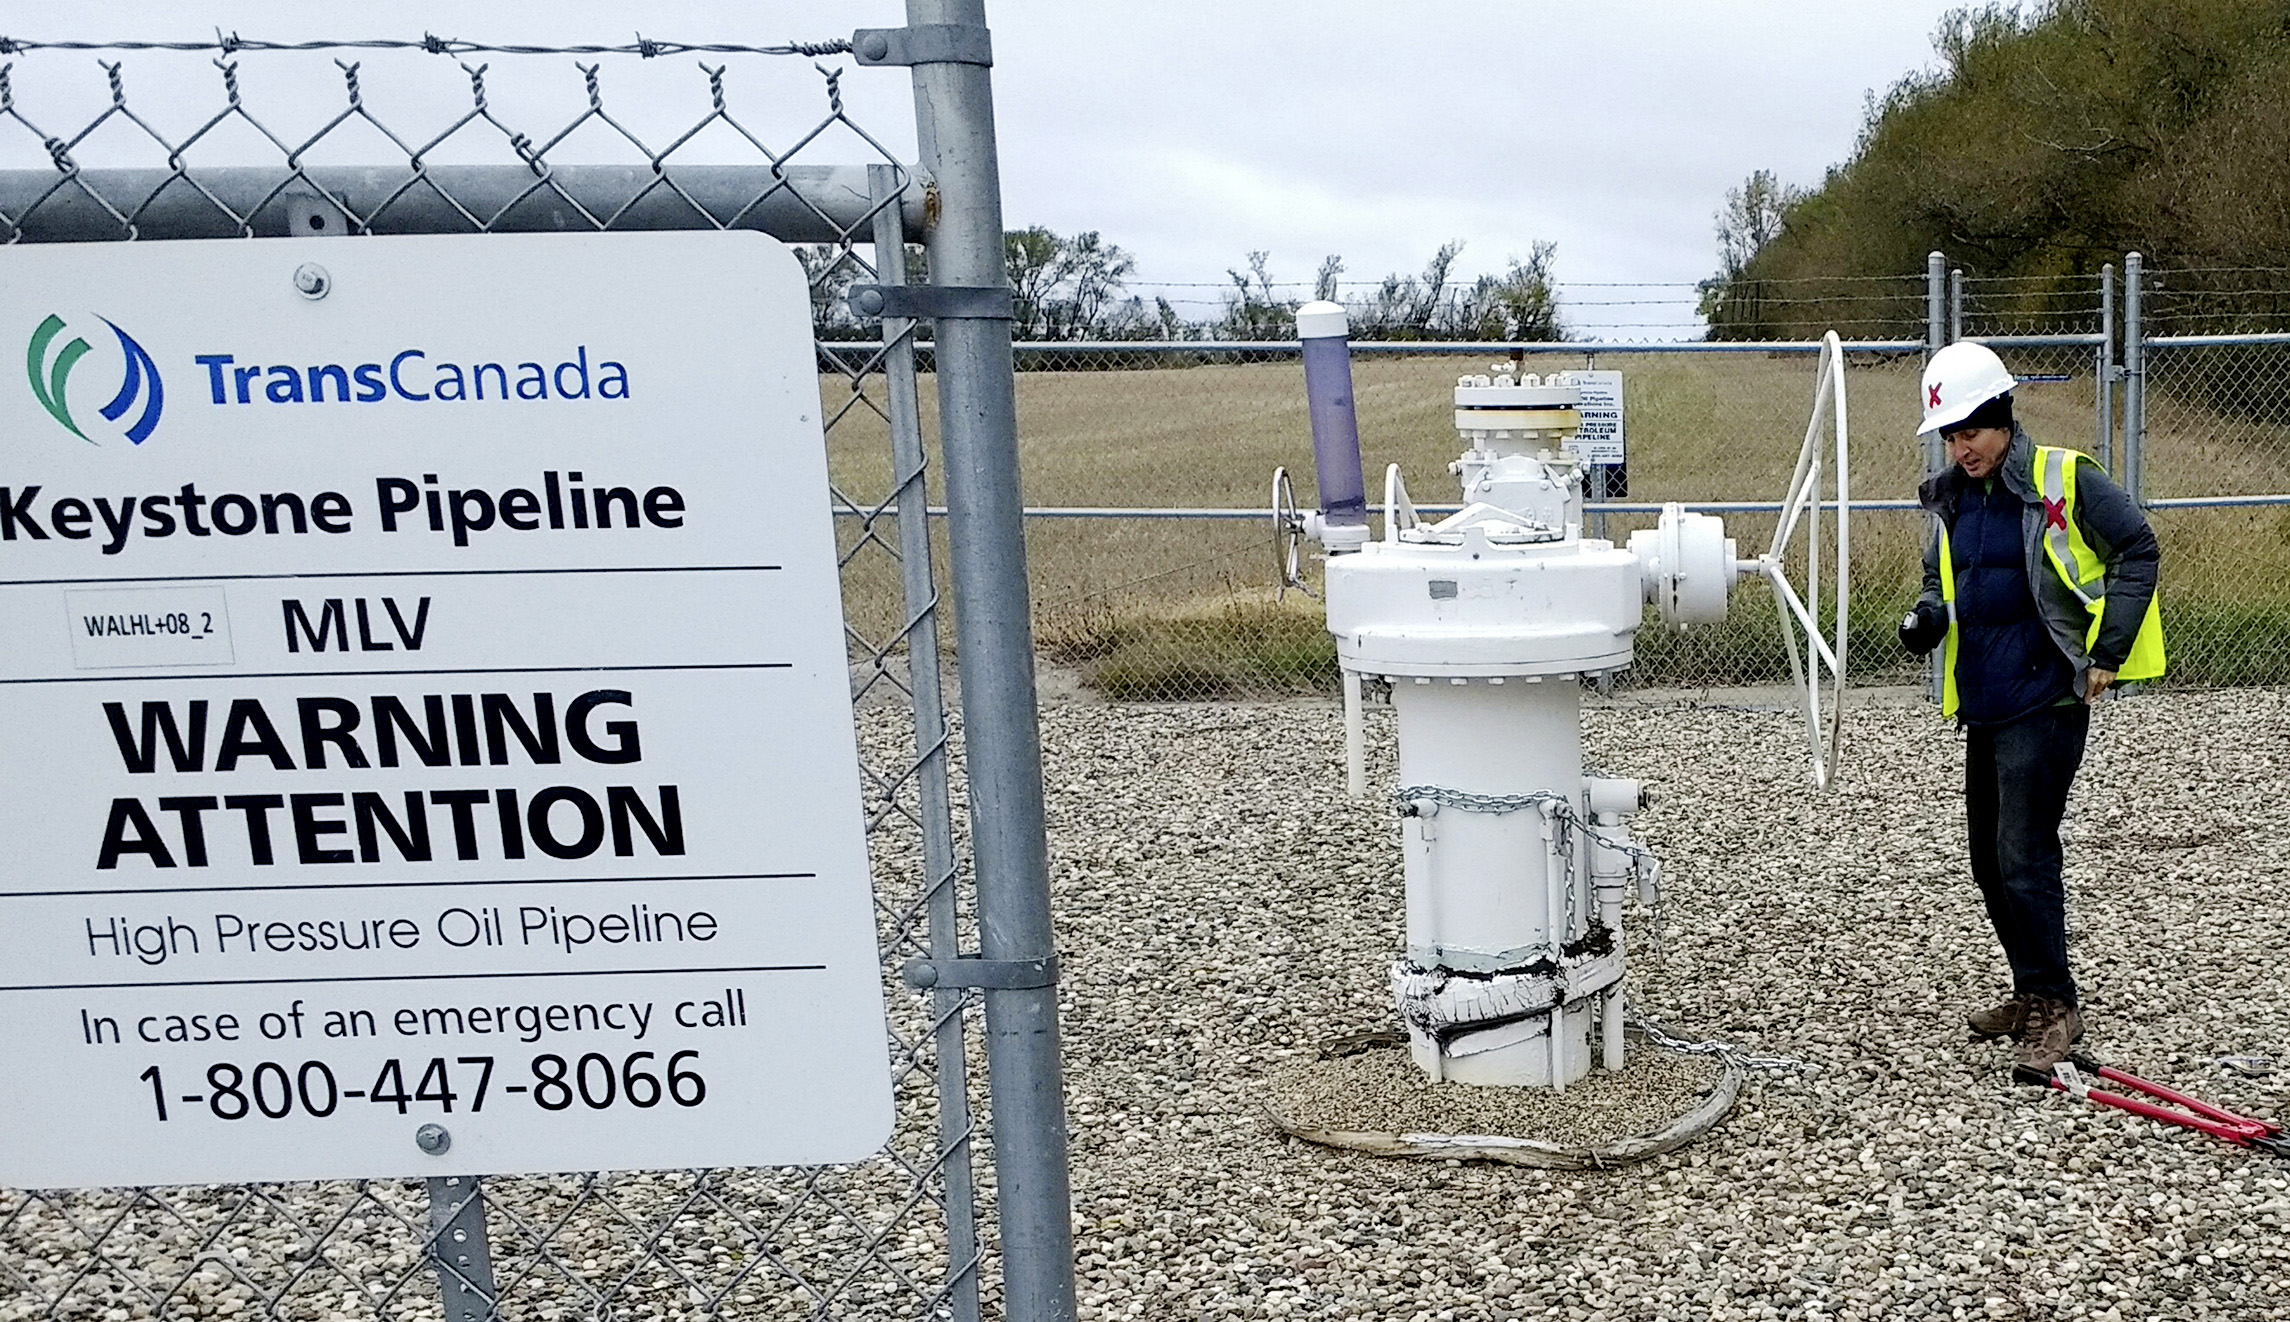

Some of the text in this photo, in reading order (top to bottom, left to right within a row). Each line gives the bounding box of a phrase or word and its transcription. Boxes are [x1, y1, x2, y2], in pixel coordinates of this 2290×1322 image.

[195, 345, 630, 406] TransCanada
[0, 471, 686, 555] Keystone Pipeline
[83, 612, 214, 640] WALHL+08_2
[282, 597, 431, 653] MLV
[102, 689, 643, 774] WARNING
[96, 785, 686, 870] ATTENTION
[85, 903, 718, 966] High Pressure Oil Pipeline
[80, 988, 747, 1045] In case of an emergency call
[139, 1050, 707, 1122] 1-800-447-8066
